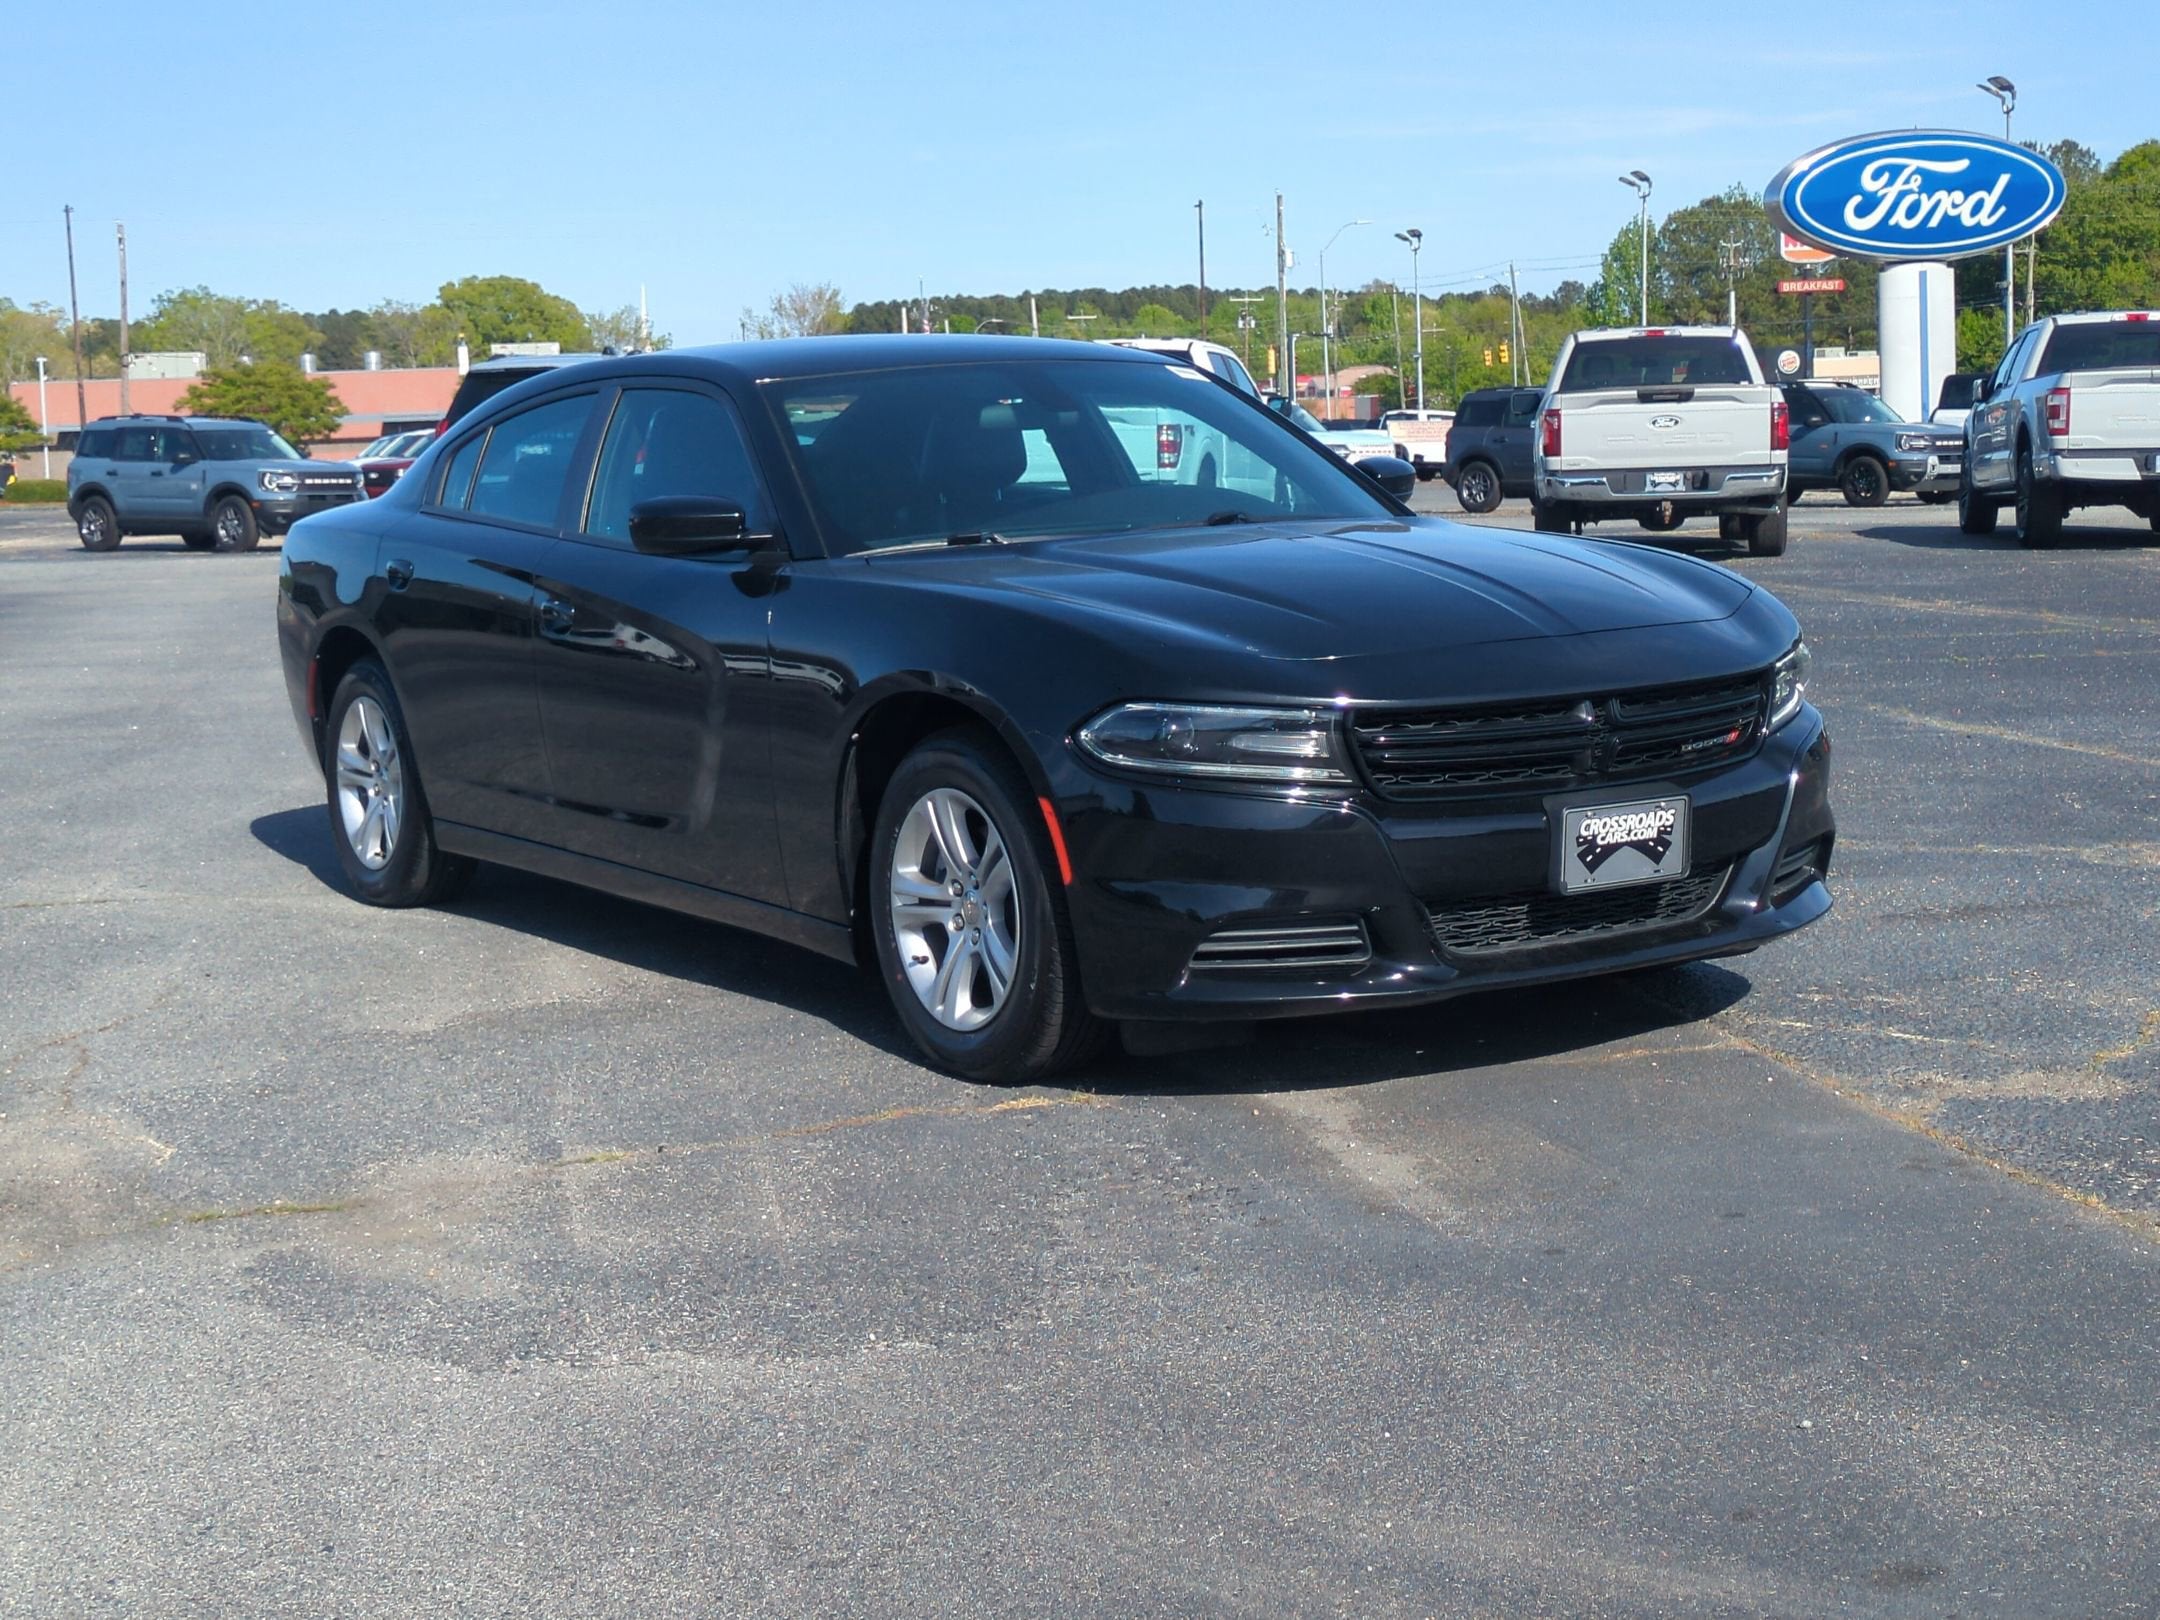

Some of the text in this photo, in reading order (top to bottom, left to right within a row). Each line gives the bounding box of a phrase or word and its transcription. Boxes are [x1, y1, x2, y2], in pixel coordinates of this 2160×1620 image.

[1844, 157, 2011, 231] Ford
[1782, 281, 1839, 292] BREAKFAST
[1580, 809, 1676, 837] CROSSROADS
[1596, 827, 1658, 845] CARS.COM
